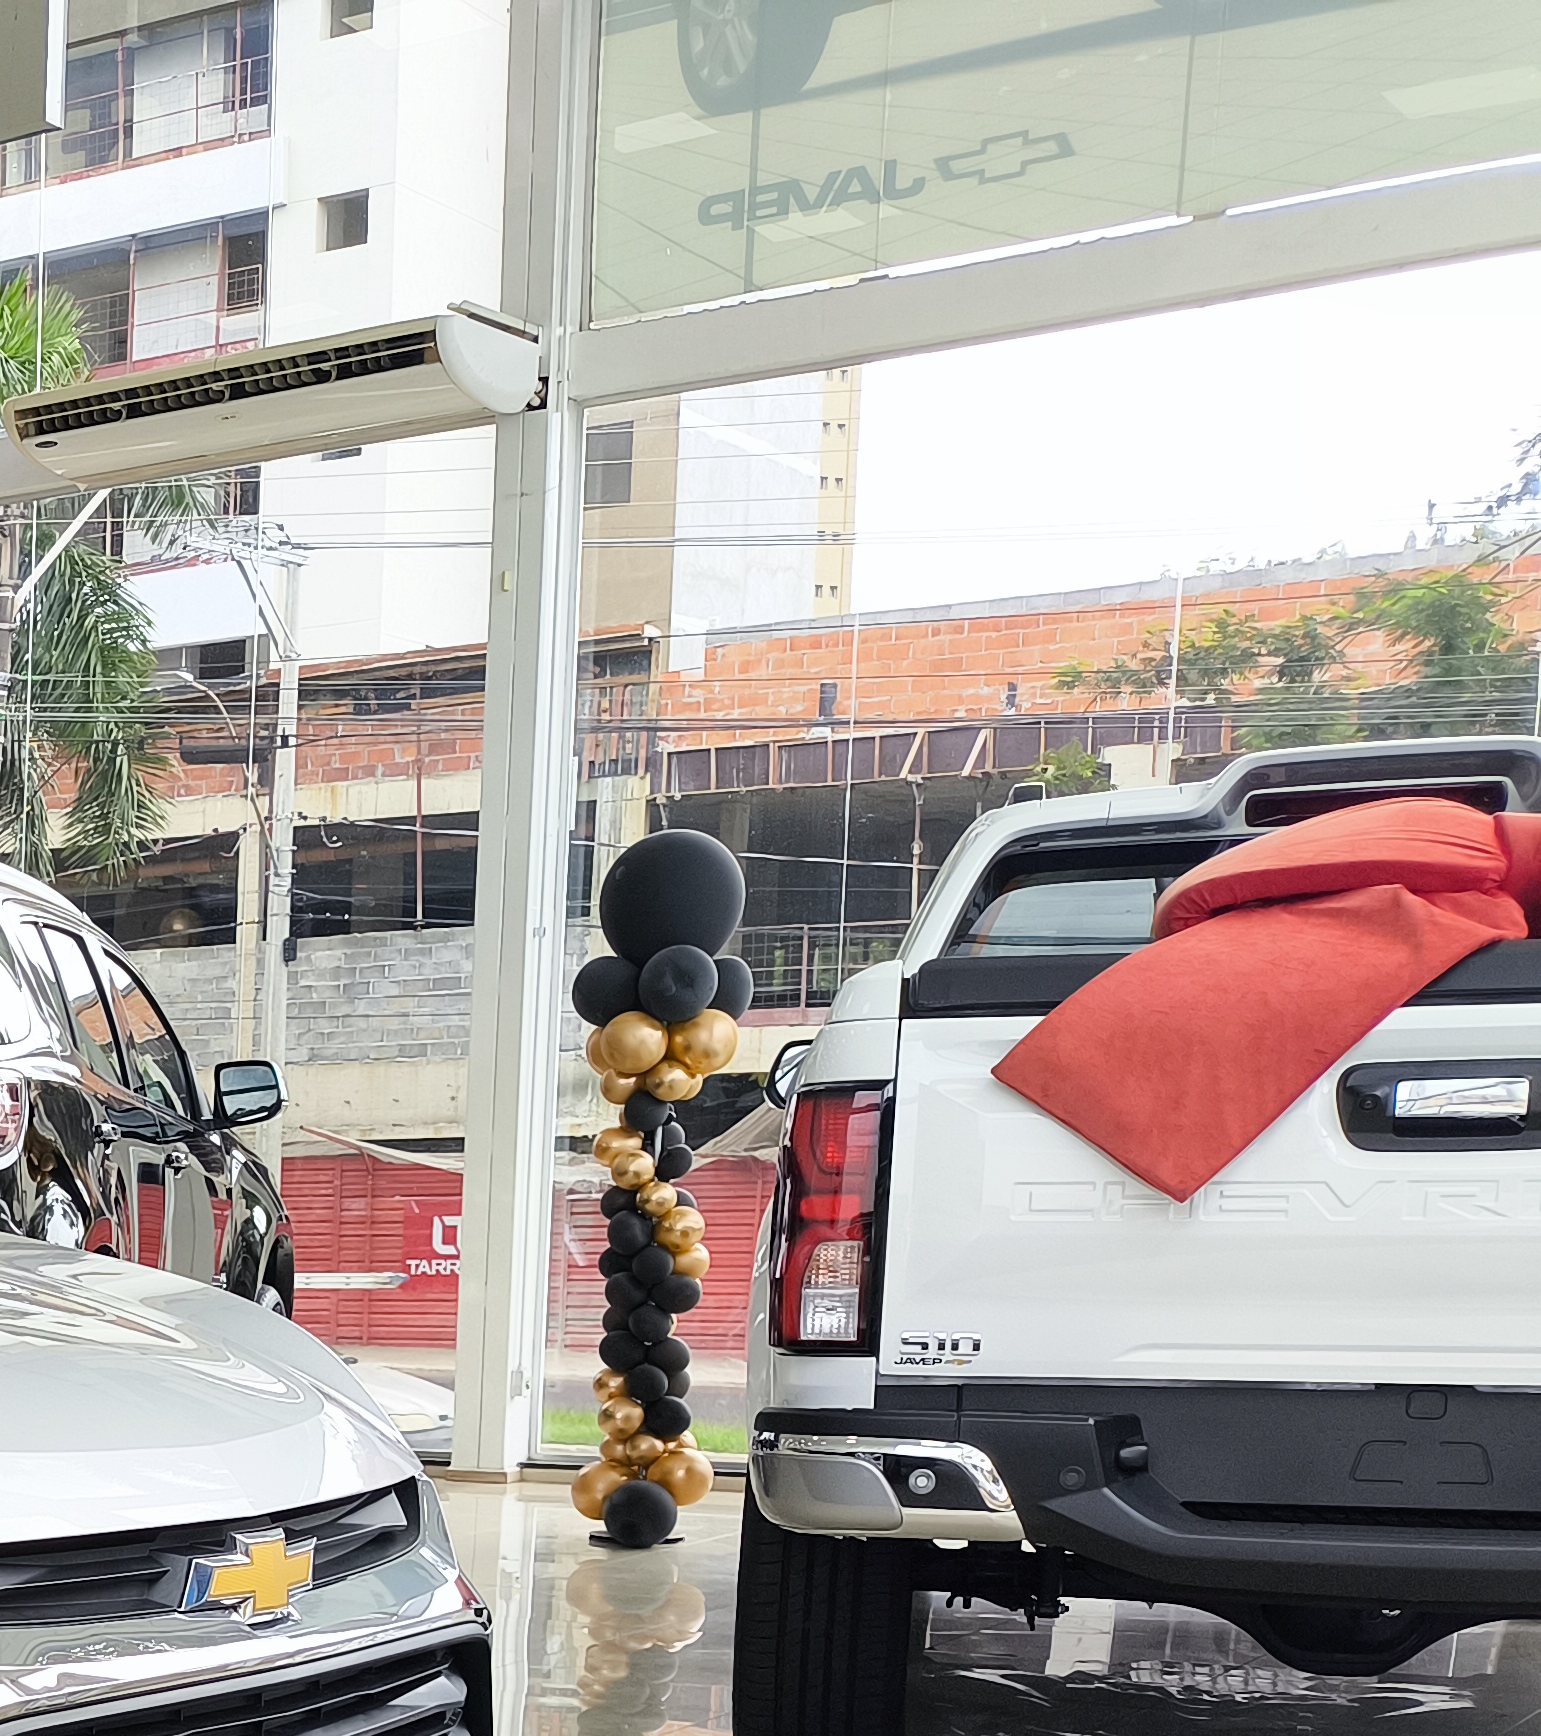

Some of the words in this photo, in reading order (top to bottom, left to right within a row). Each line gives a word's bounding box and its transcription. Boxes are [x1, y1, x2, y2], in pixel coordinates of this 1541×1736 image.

[1010, 1180, 1541, 1222] CHEVR
[899, 1331, 982, 1356] S10
[894, 1357, 943, 1366] JAVEP
